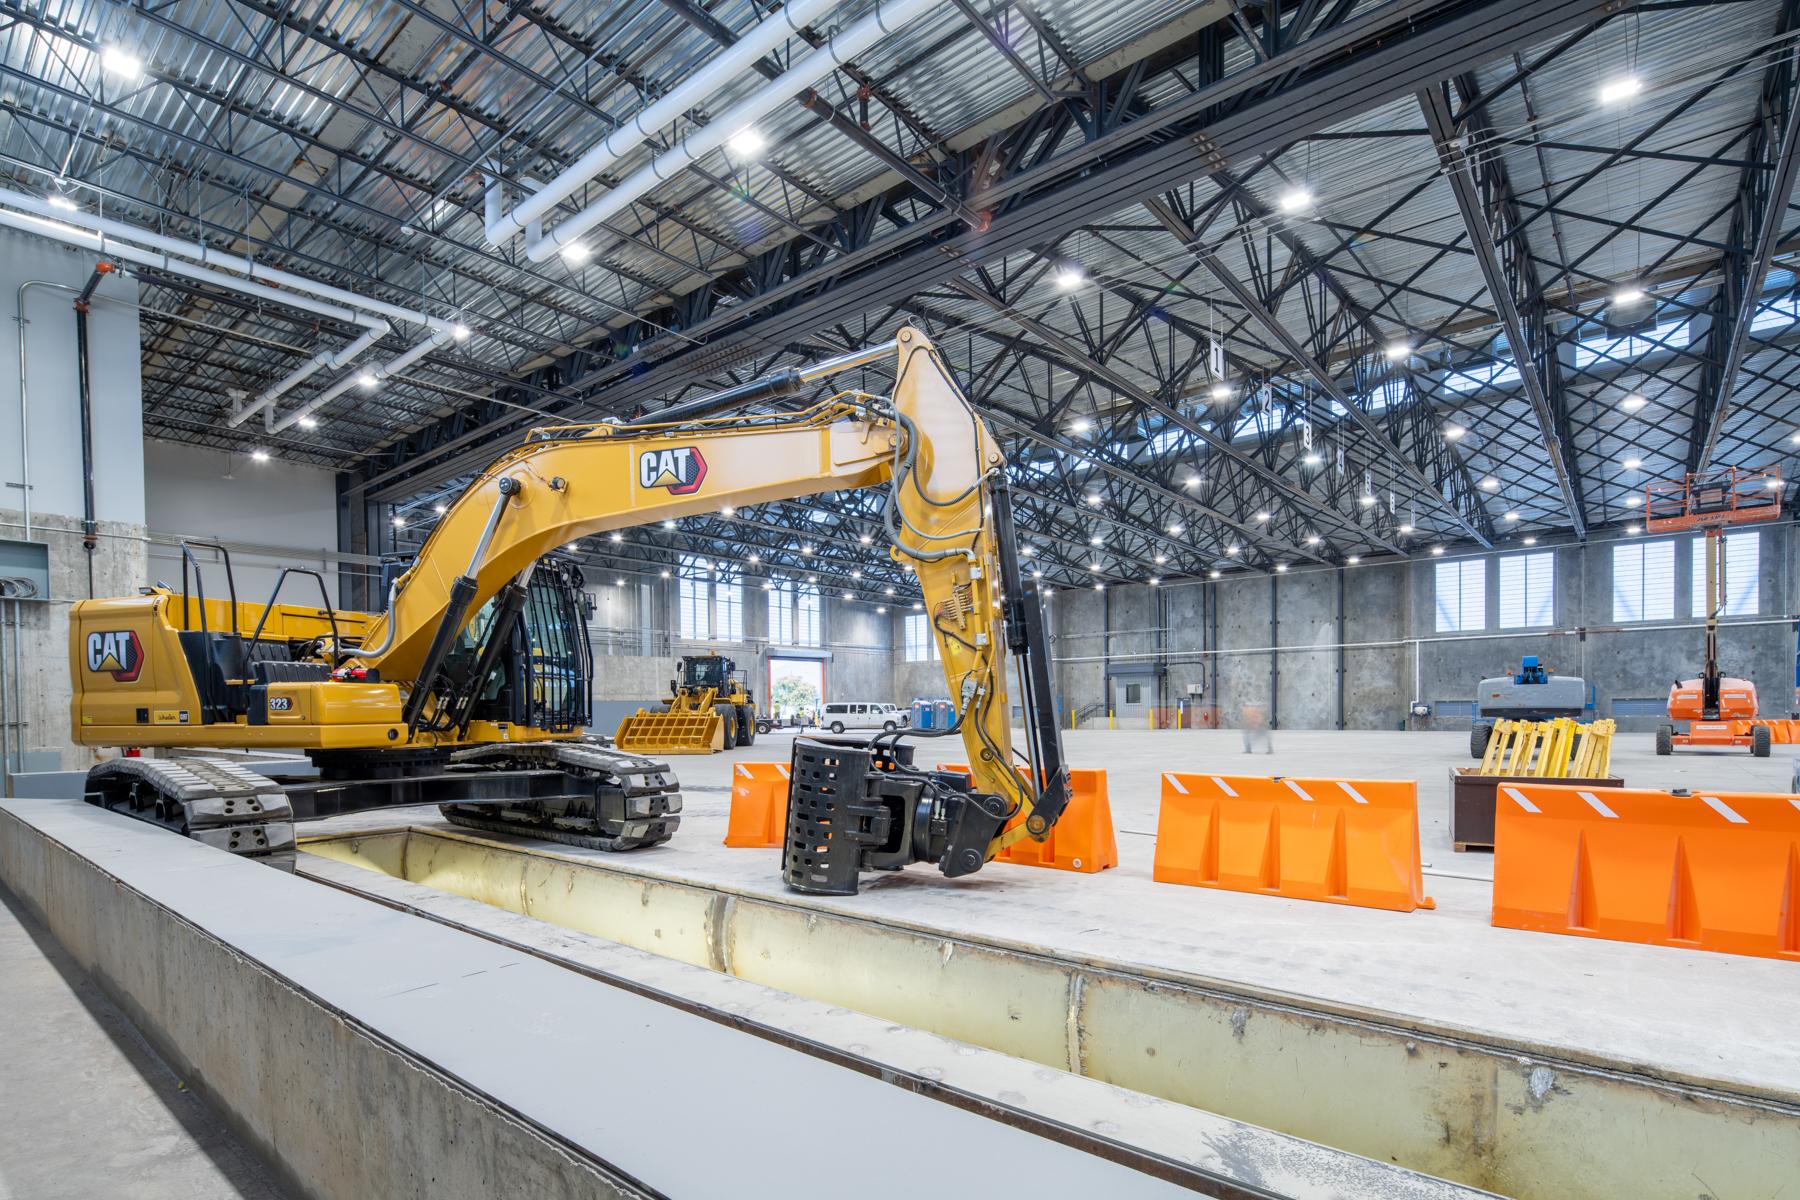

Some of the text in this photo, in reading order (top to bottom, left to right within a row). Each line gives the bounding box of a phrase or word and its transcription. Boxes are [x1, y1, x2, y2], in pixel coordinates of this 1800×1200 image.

[641, 448, 690, 488] CAT
[88, 631, 130, 671] CAT
[270, 698, 288, 709] 323
